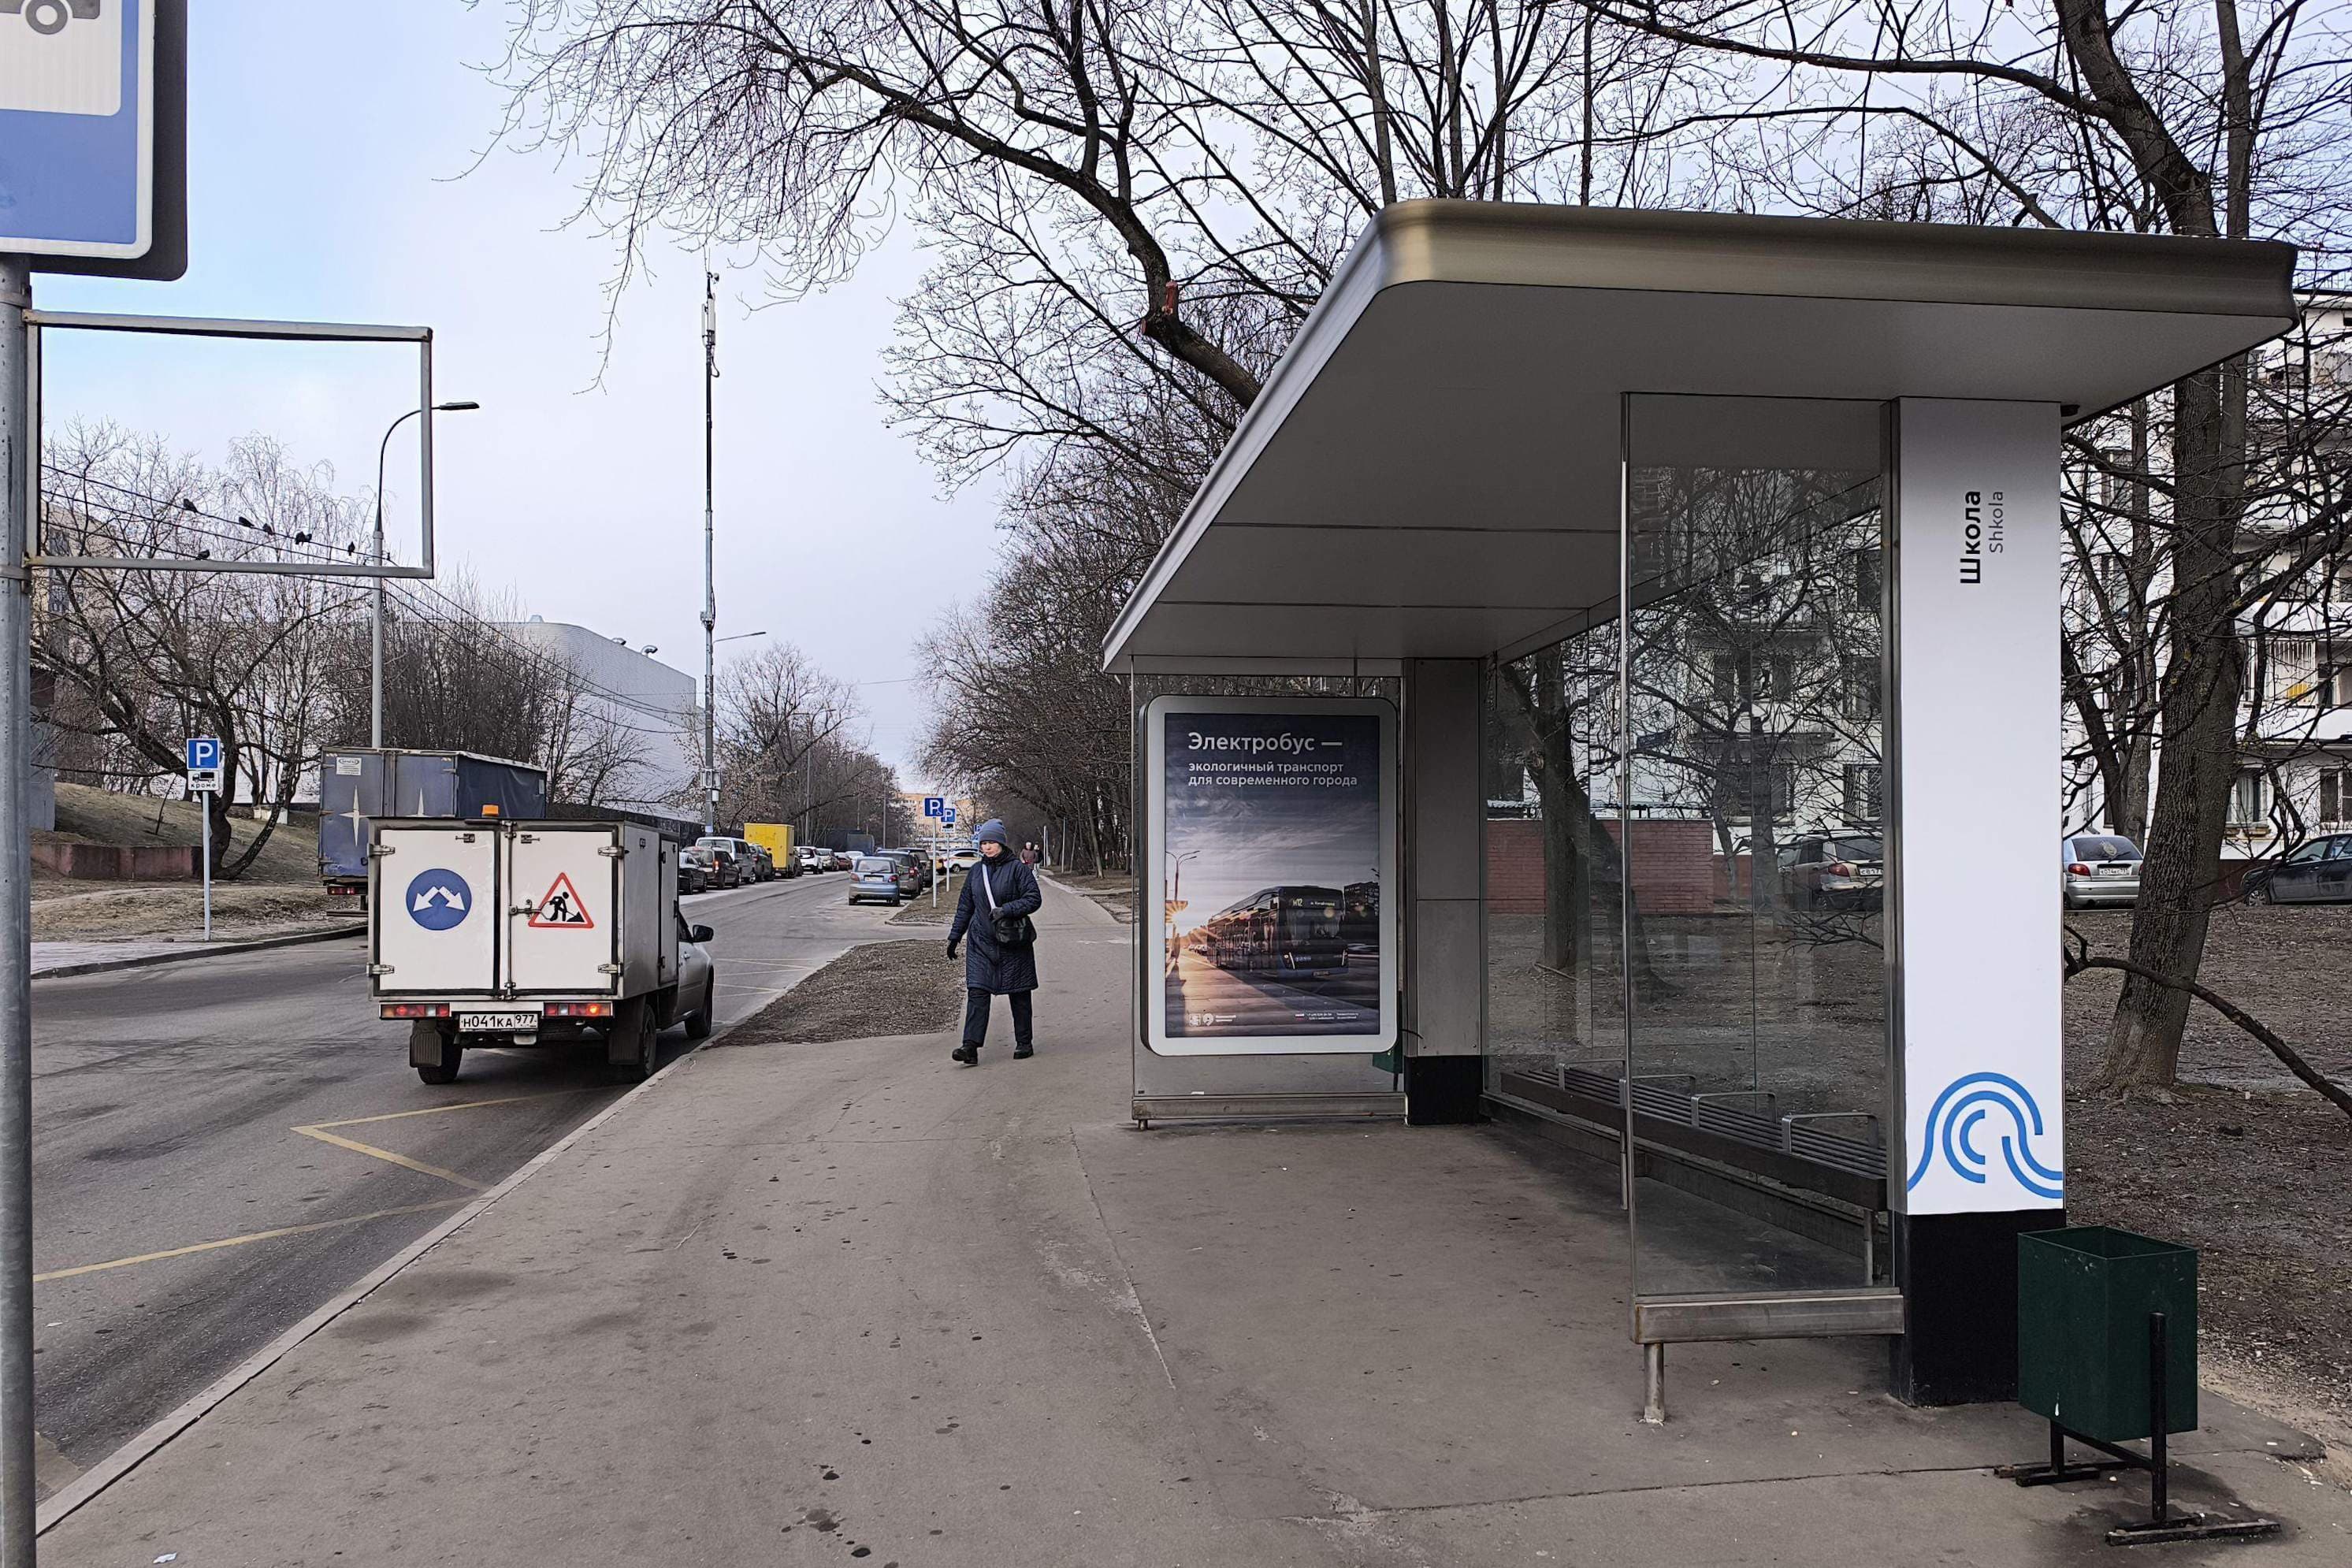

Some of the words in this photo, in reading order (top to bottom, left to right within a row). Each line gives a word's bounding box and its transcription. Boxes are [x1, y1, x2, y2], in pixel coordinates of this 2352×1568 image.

[1988, 491, 2004, 553] Shkola
[1960, 491, 1981, 584] Школа
[196, 742, 214, 766] P
[1187, 732, 1316, 754] Электробус
[1187, 761, 1275, 772] экологичный
[1276, 762, 1344, 775] транспорт
[1187, 775, 1213, 786] для
[1215, 775, 1310, 788] современного
[1312, 775, 1358, 787] города
